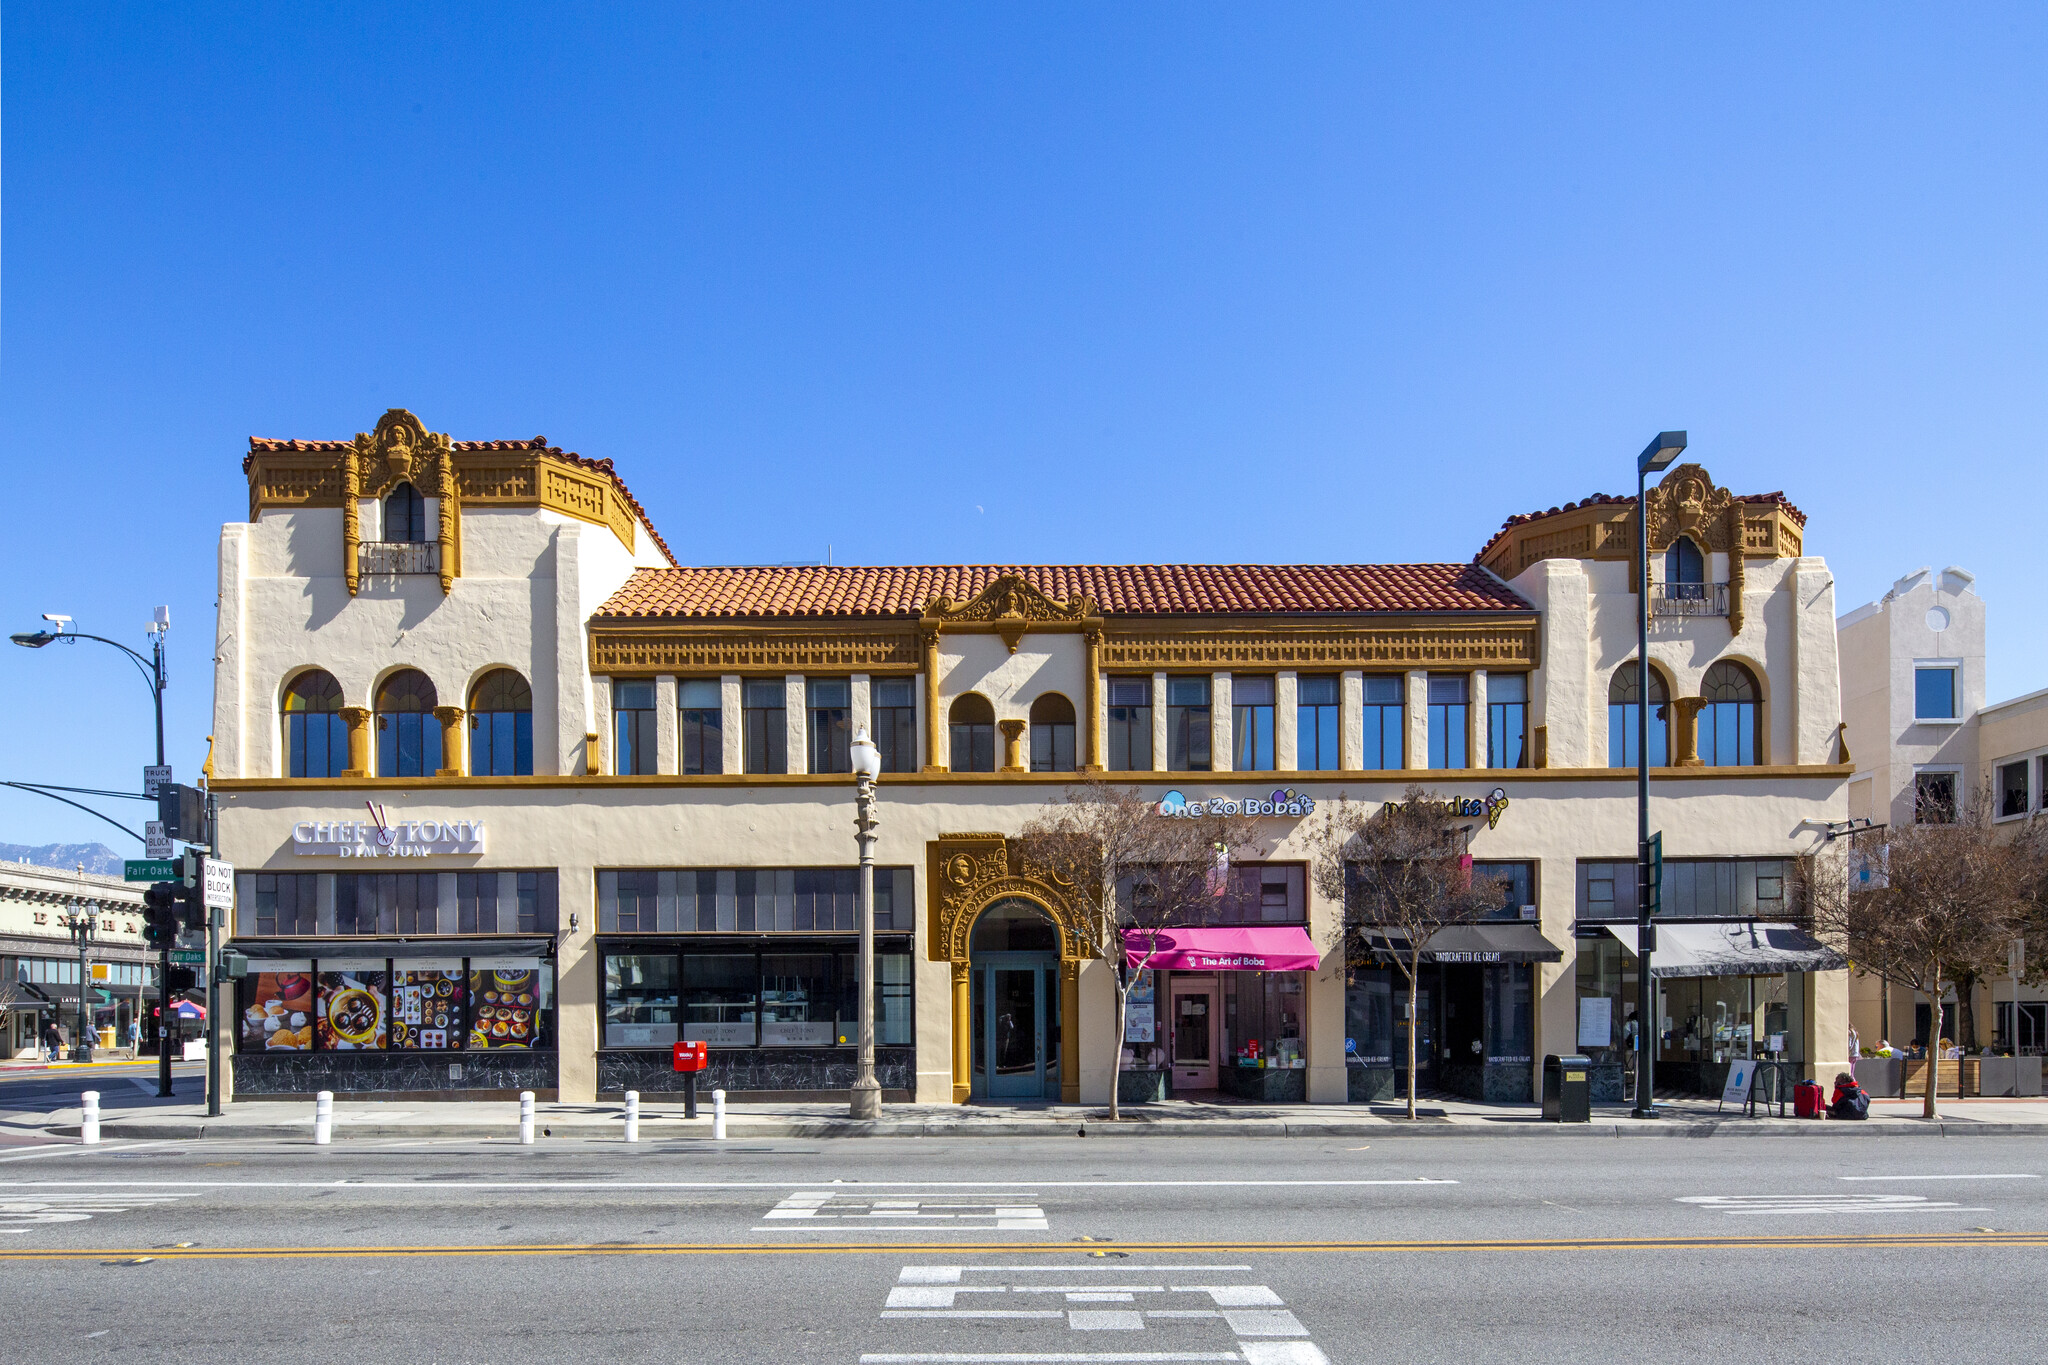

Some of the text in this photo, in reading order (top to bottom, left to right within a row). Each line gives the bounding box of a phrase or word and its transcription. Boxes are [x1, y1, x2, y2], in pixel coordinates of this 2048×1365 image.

[1159, 795, 1301, 818] One Zo Boba
[147, 826, 156, 835] DO
[292, 819, 485, 843] CHEF TONY
[148, 838, 170, 847] BLOCK
[339, 845, 428, 858] DIM SUM
[127, 866, 174, 875] Fair Oaks
[206, 865, 231, 879] DO NOT
[207, 880, 231, 893] BLOCK
[186, 952, 202, 961] Oaks
[1201, 956, 1265, 966] The Art of Boba
[1435, 951, 1500, 962] HANDCRAFTED ICE CREAM
